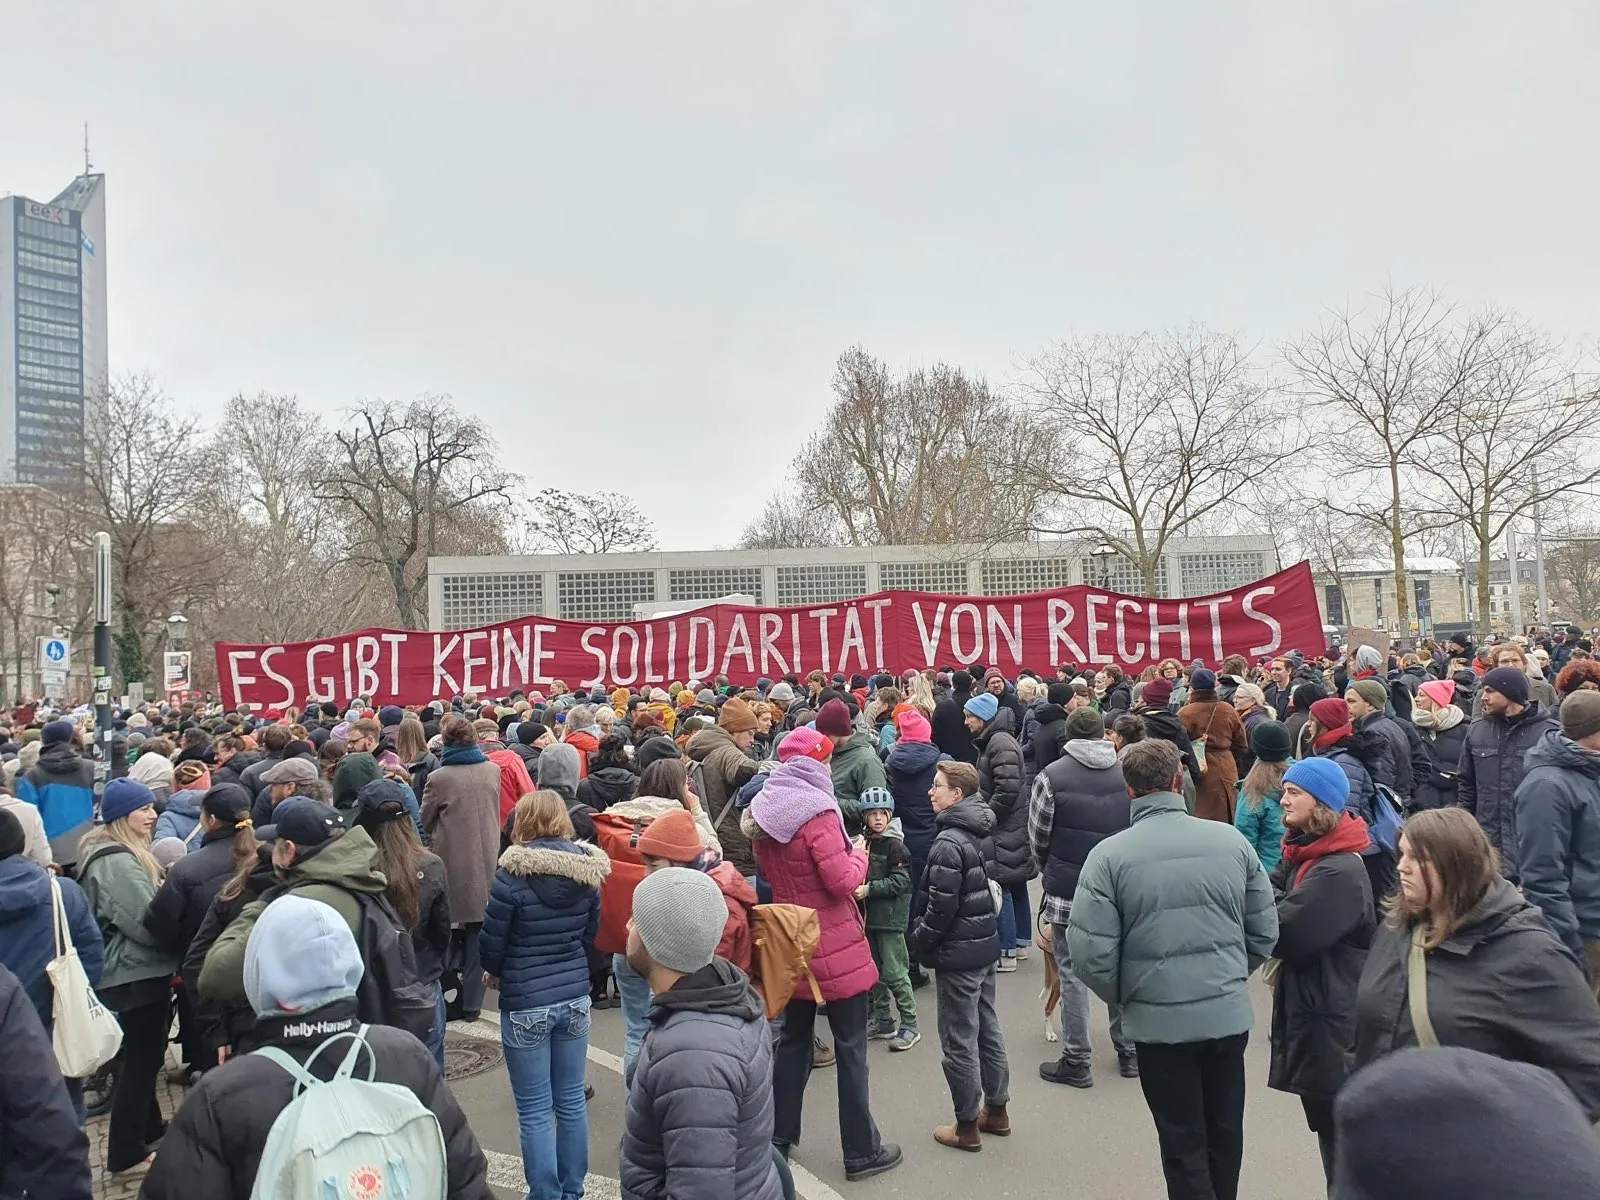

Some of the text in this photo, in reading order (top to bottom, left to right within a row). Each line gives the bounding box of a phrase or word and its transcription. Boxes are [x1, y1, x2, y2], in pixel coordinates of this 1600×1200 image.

[228, 585, 1282, 711] ES GIBT KEINE SOLIDARITÄT VON RECHTS
